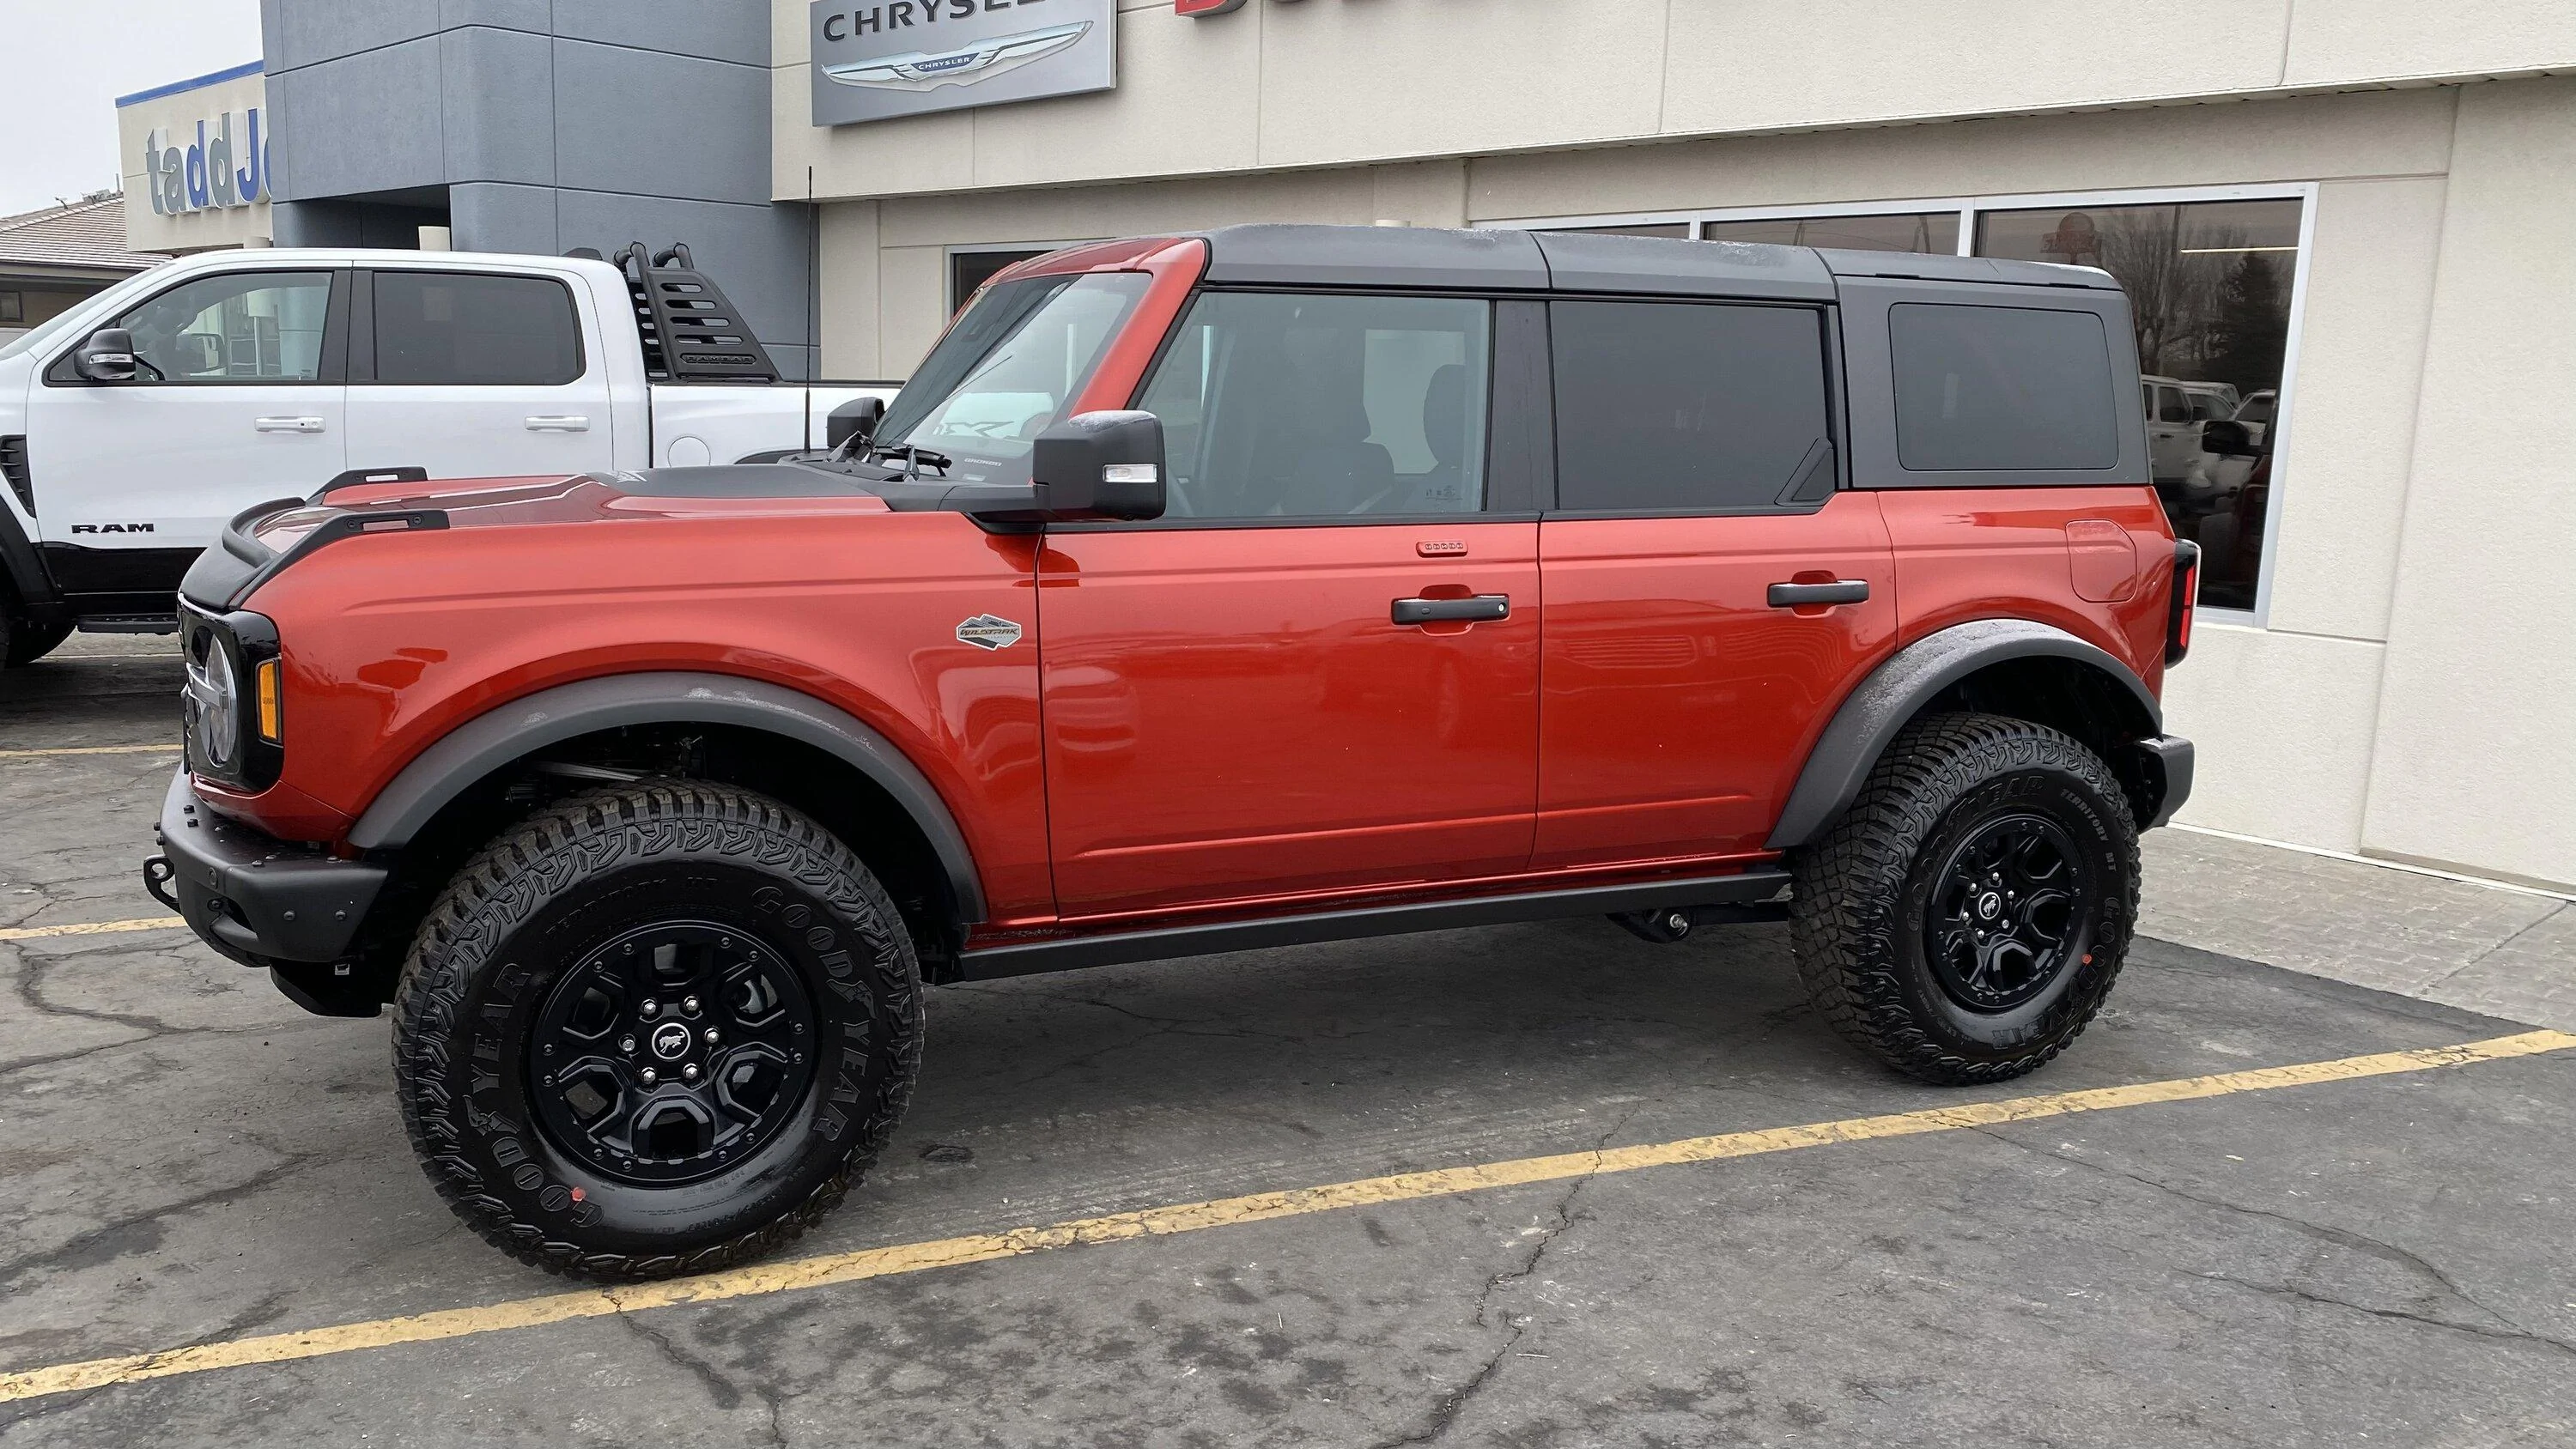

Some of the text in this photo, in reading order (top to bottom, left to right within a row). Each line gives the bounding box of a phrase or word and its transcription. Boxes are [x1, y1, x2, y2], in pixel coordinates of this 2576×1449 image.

[917, 56, 970, 70] CHRYSLER
[145, 107, 270, 215] taddJ
[71, 523, 155, 534] RAM
[2060, 788, 2117, 872] TERRITORY MT
